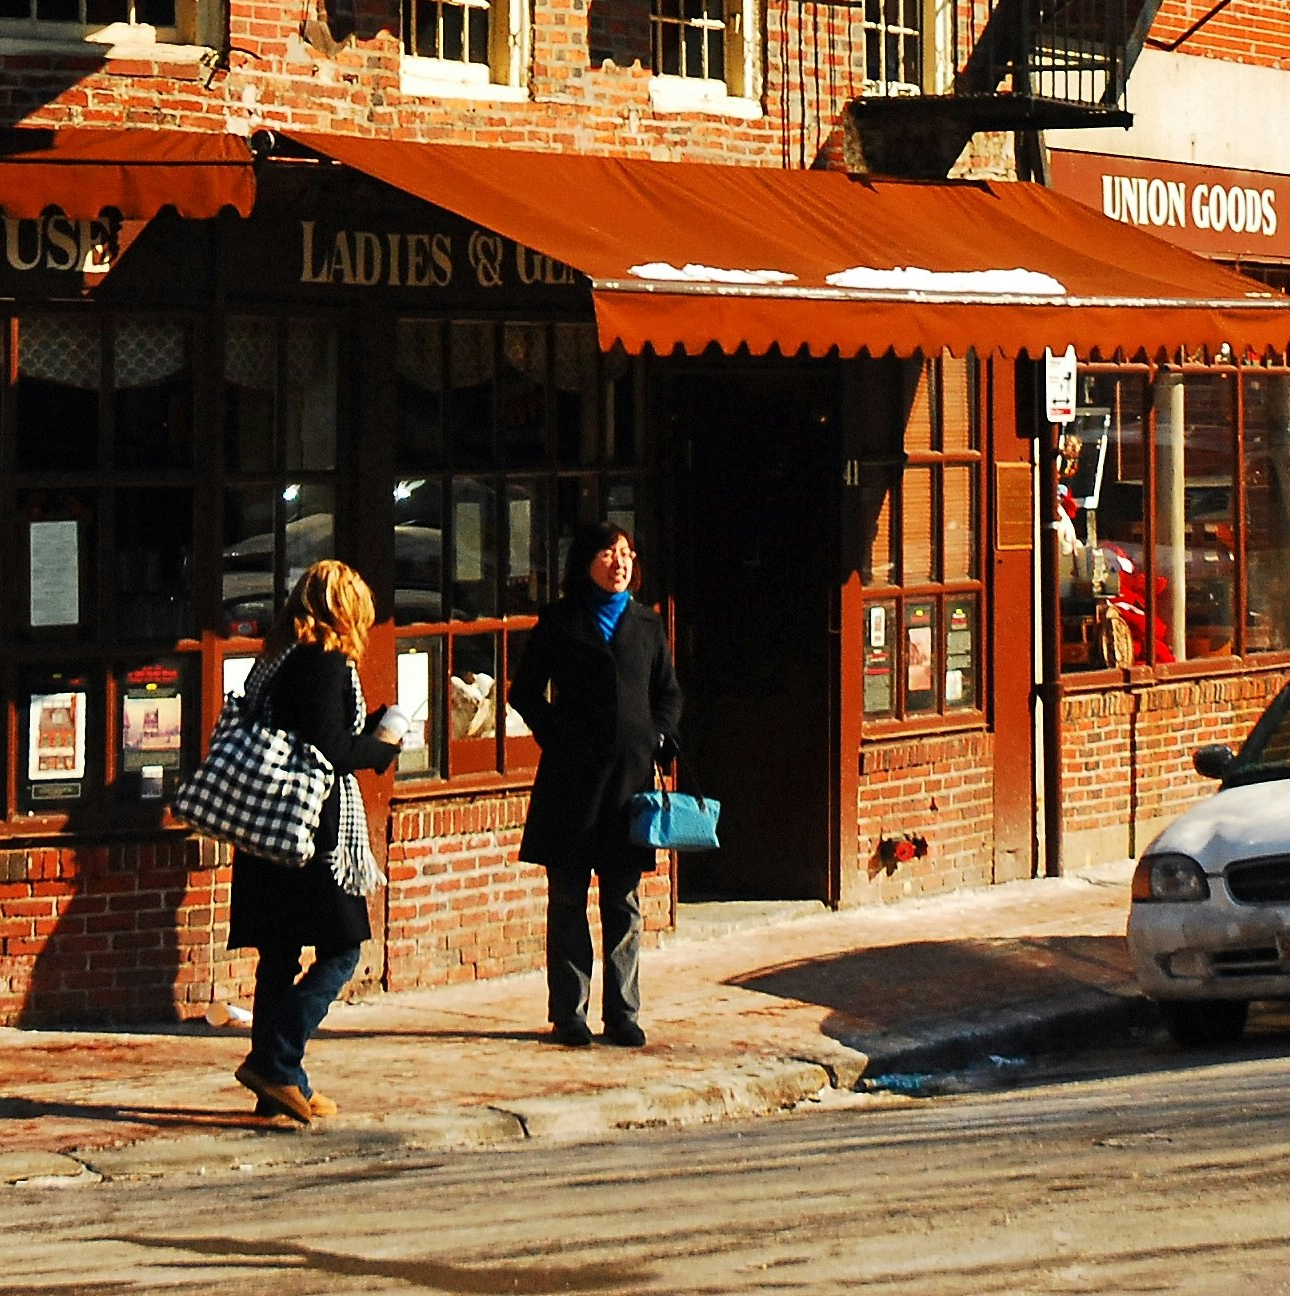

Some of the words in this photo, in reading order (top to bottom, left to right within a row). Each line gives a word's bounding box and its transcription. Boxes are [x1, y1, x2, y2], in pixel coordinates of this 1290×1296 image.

[1101, 174, 1187, 229] UNION
[1192, 184, 1278, 237] GOODS
[299, 220, 453, 286] LADIES
[468, 230, 504, 287] &
